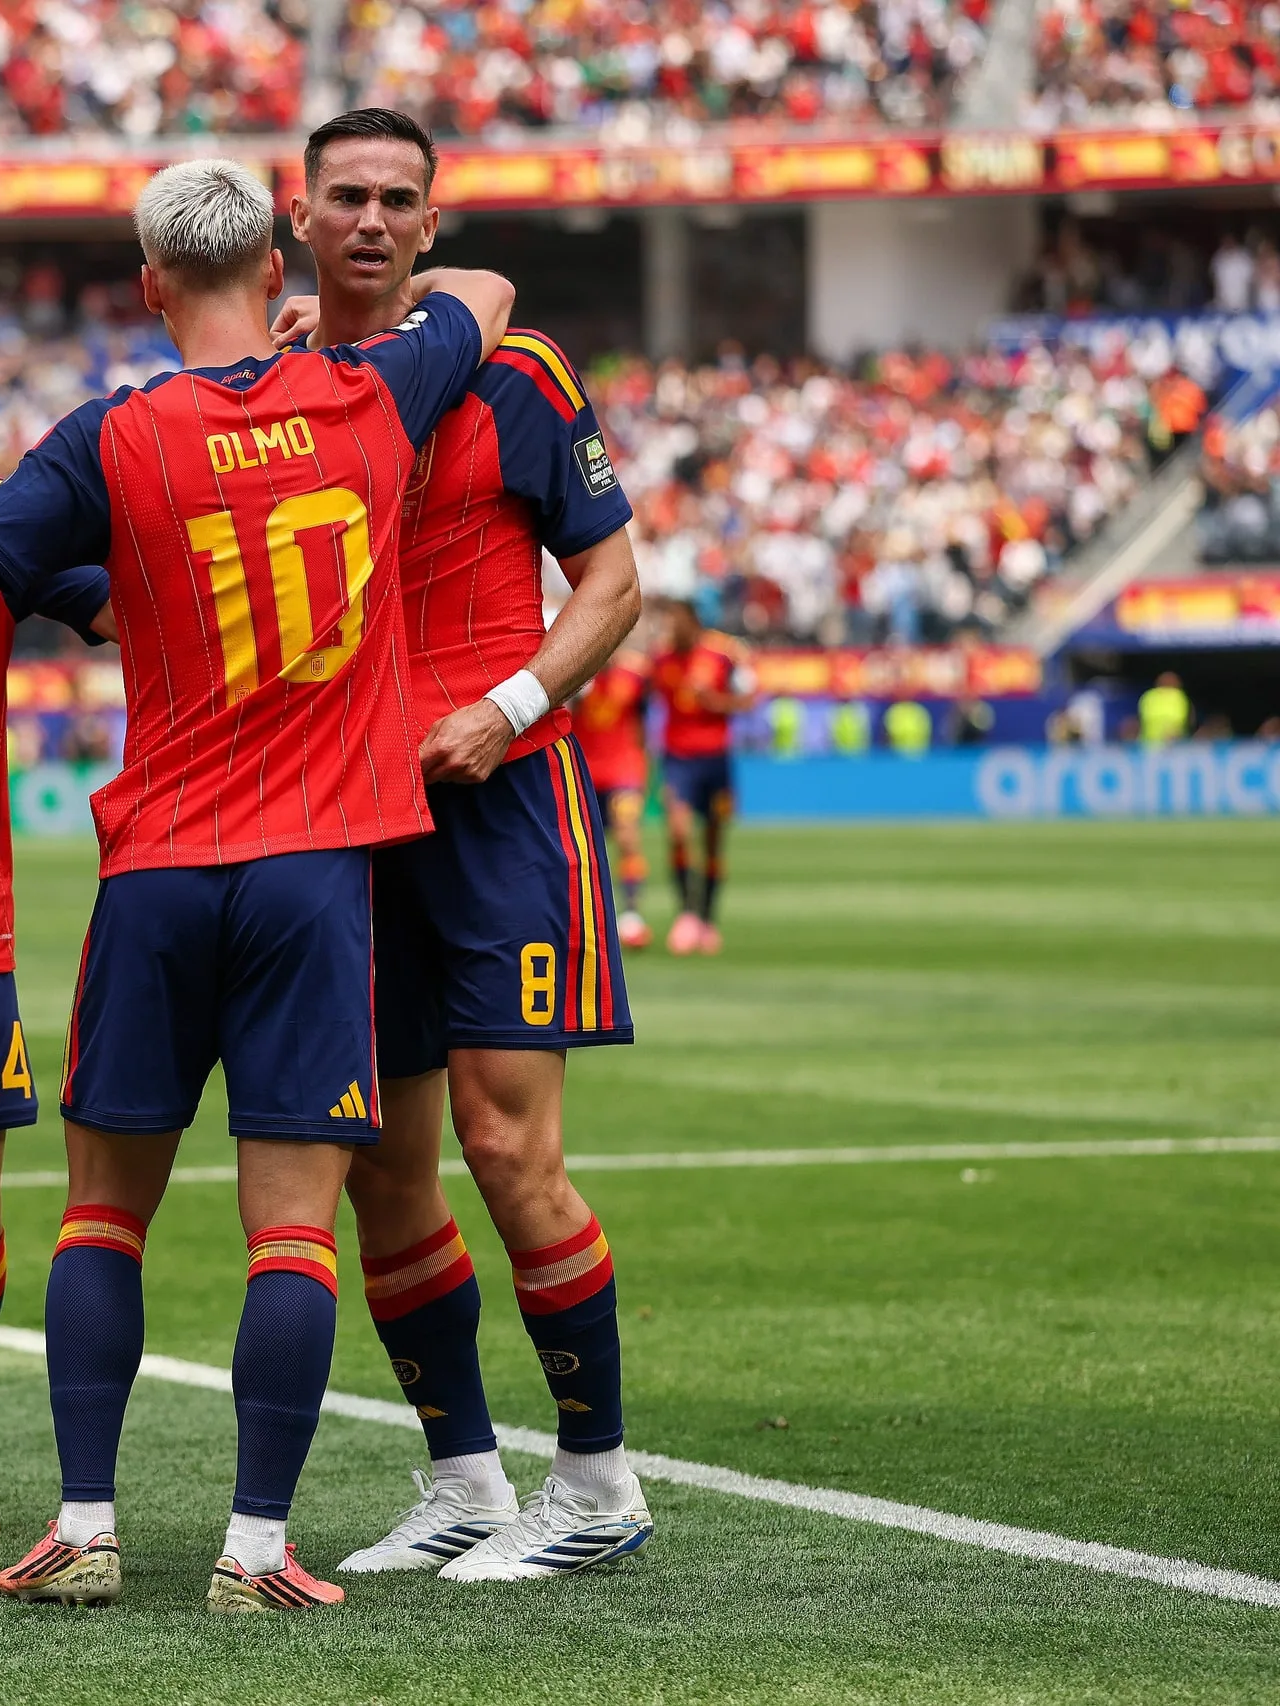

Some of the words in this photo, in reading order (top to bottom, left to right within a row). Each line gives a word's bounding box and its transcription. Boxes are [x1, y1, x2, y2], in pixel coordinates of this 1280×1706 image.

[220, 369, 256, 385] España
[206, 416, 316, 474] OLMO
[185, 487, 375, 710] 10
[521, 942, 556, 1026] 8
